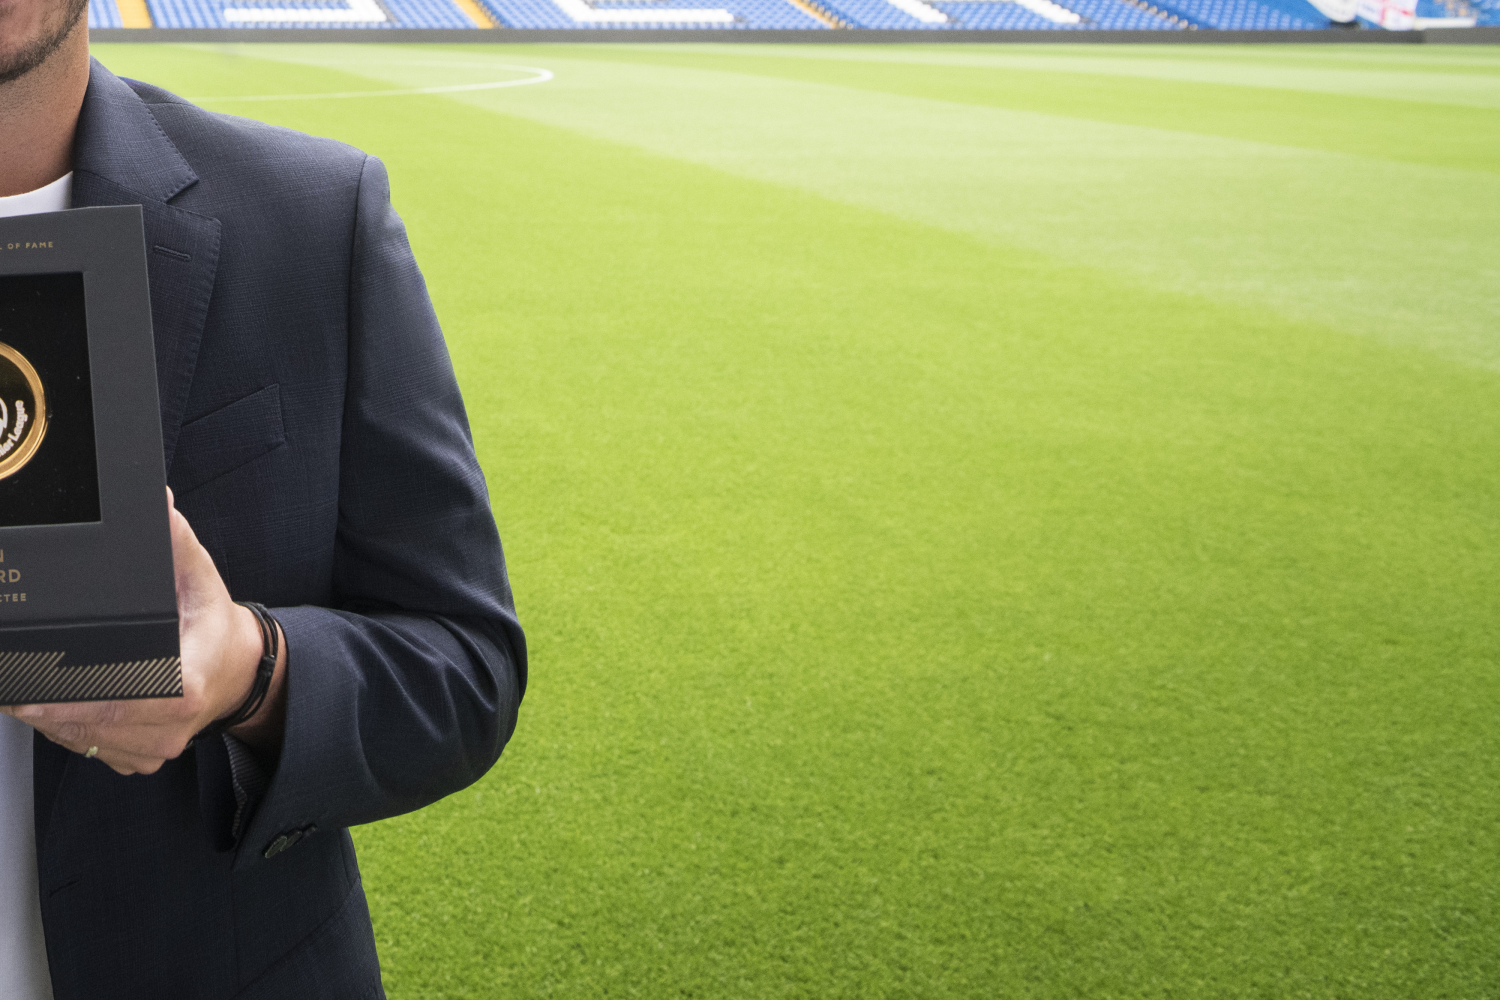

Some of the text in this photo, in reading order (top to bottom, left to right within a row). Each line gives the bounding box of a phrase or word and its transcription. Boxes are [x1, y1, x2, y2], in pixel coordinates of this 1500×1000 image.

[7, 242, 21, 250] OF
[25, 241, 53, 249] FAME
[8, 400, 28, 441] League
